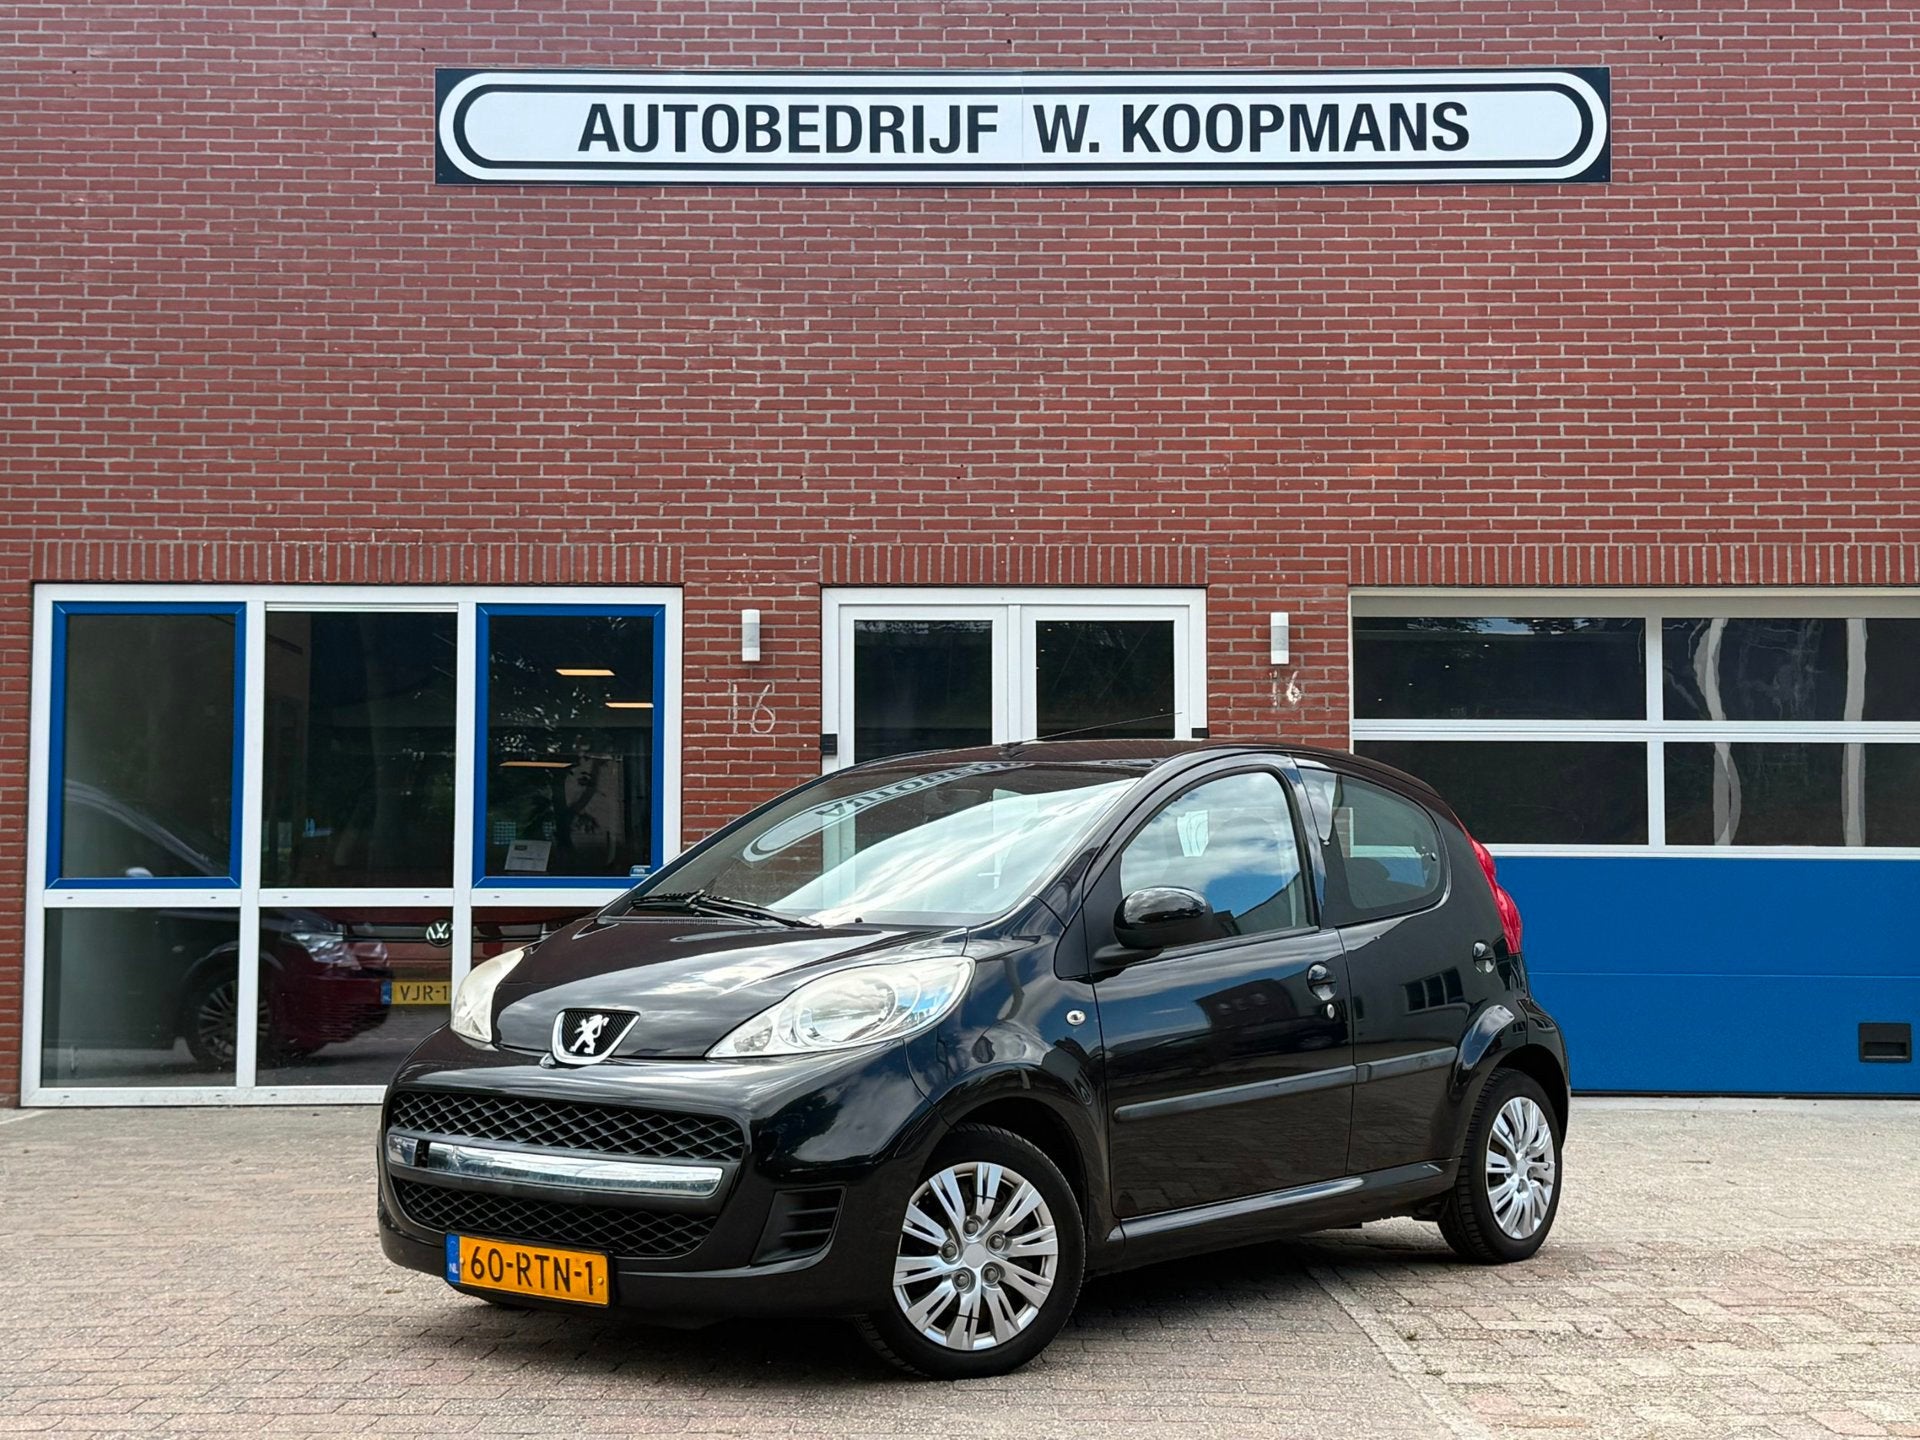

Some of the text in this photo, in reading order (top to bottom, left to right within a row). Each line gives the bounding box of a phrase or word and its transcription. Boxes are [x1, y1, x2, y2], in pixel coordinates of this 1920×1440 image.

[577, 102, 1470, 153] AUTOBEDRIJF W. KOOPMANS
[732, 683, 776, 735] 16
[399, 984, 448, 1001] VJR-1
[470, 1246, 594, 1296] 60-RTN-1
